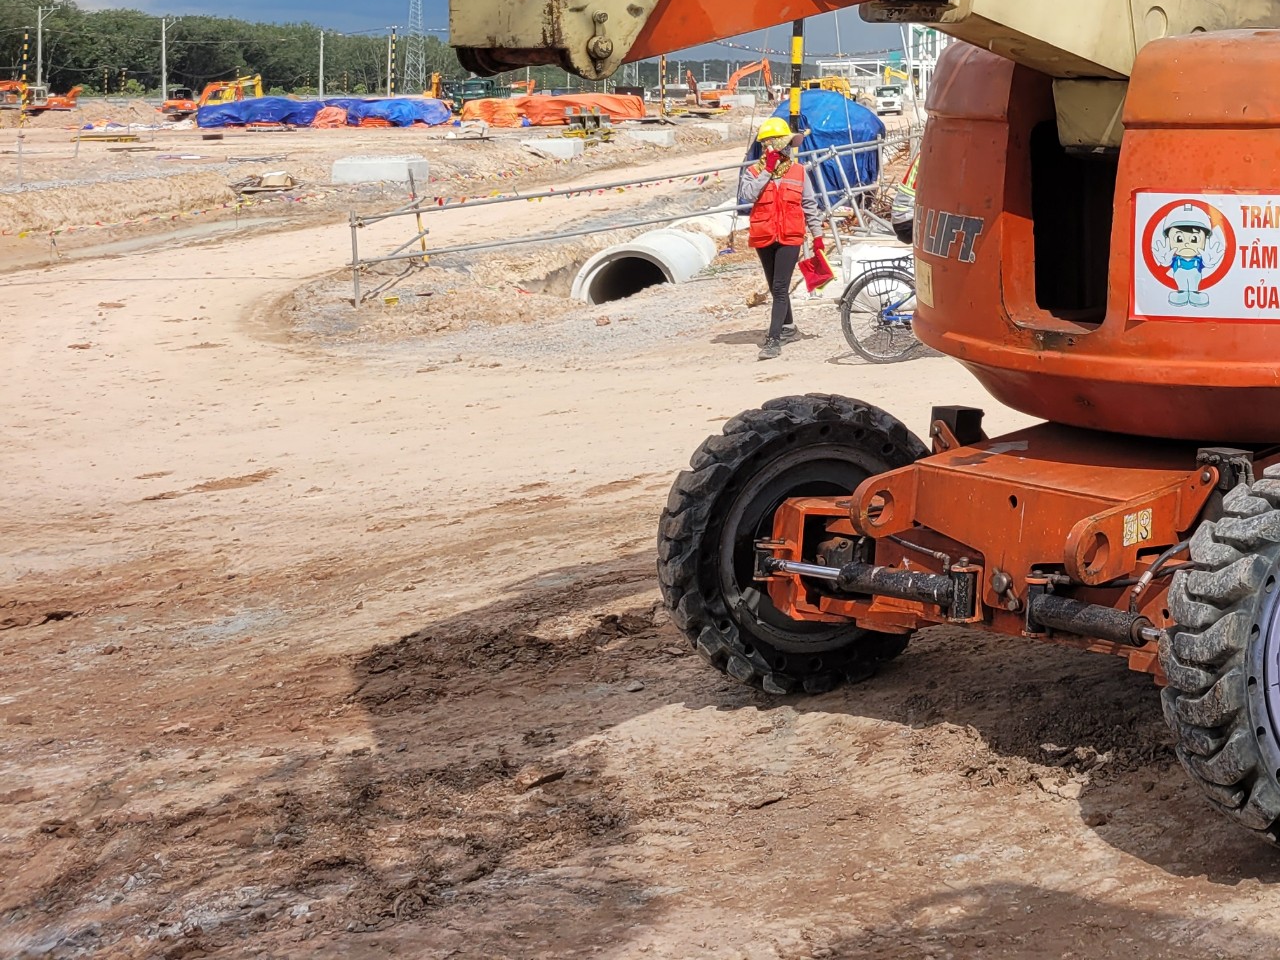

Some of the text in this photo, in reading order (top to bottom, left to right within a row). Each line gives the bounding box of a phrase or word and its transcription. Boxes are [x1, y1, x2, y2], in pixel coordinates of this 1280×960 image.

[923, 208, 984, 262] LIFT
[1239, 238, 1278, 269] TẦM
[1244, 278, 1280, 309] CỦA
